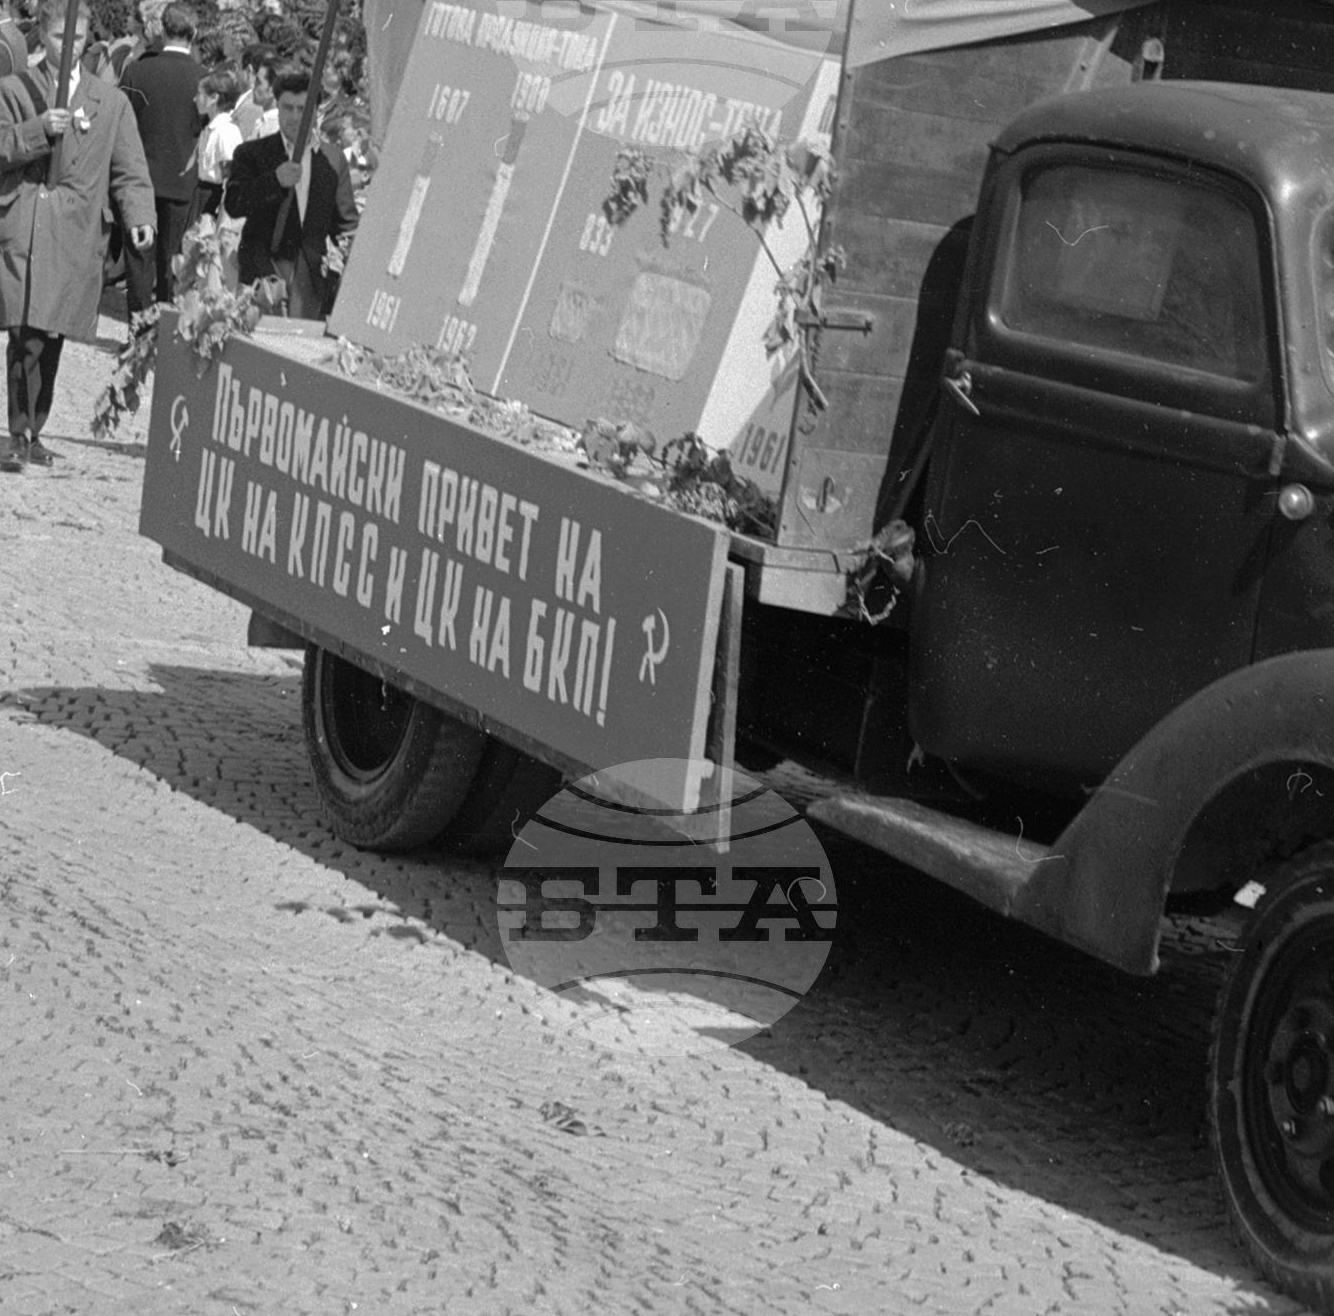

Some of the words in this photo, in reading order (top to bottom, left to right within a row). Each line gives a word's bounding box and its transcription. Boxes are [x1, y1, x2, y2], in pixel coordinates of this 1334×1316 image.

[367, 289, 401, 334] 1961
[212, 361, 407, 524] ПЪРВОМАЙСКИ
[419, 458, 540, 582] ПРИВЕТ
[555, 516, 602, 615] НА
[738, 423, 787, 475] 1961
[195, 447, 236, 541] ЦК
[241, 481, 277, 565] НА
[287, 491, 378, 609] КПСС
[385, 546, 417, 625] И
[414, 547, 464, 651] ЦК
[470, 585, 511, 680] НА
[524, 598, 616, 728] БКП!
